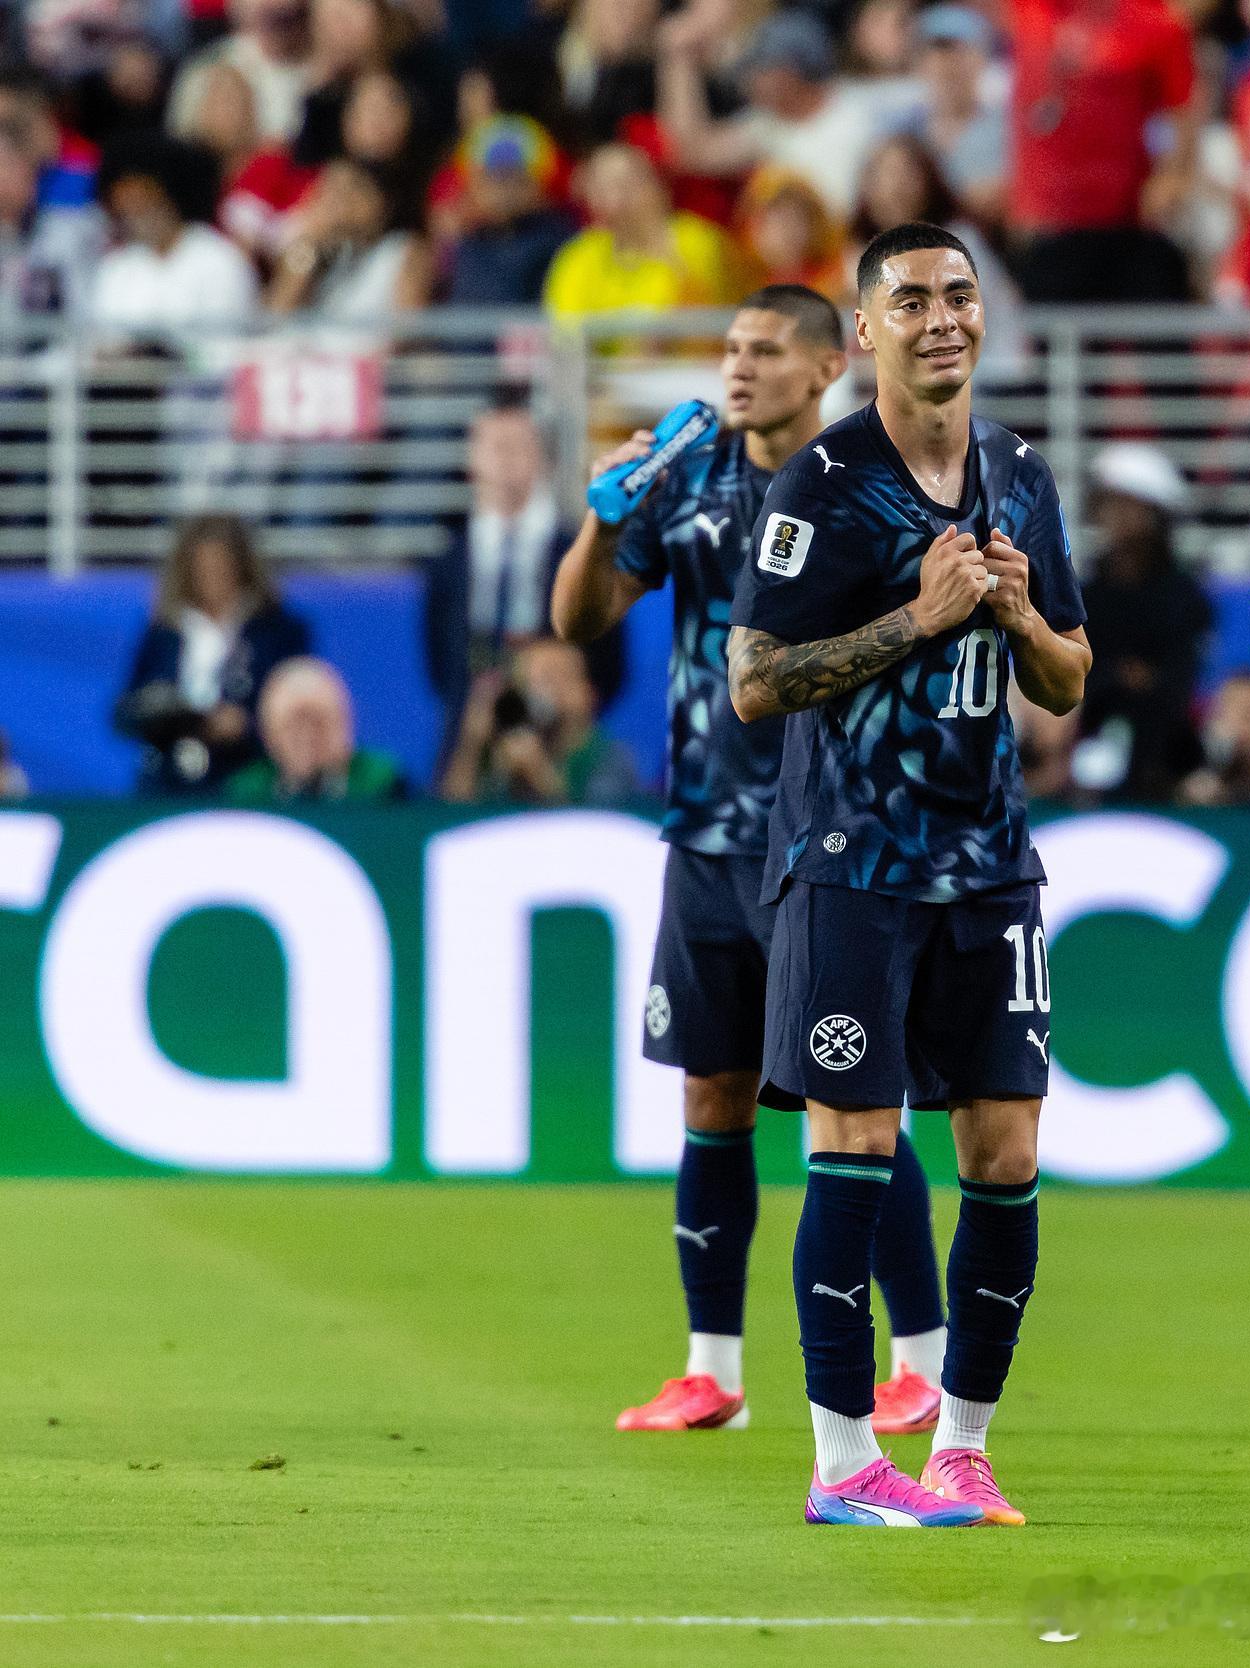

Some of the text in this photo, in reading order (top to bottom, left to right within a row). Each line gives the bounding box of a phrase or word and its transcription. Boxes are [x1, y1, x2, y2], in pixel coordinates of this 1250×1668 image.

[938, 628, 998, 719] 10
[1003, 924, 1051, 1013] 10
[830, 1019, 850, 1030] APF
[823, 1057, 850, 1068] PARAGUAY
